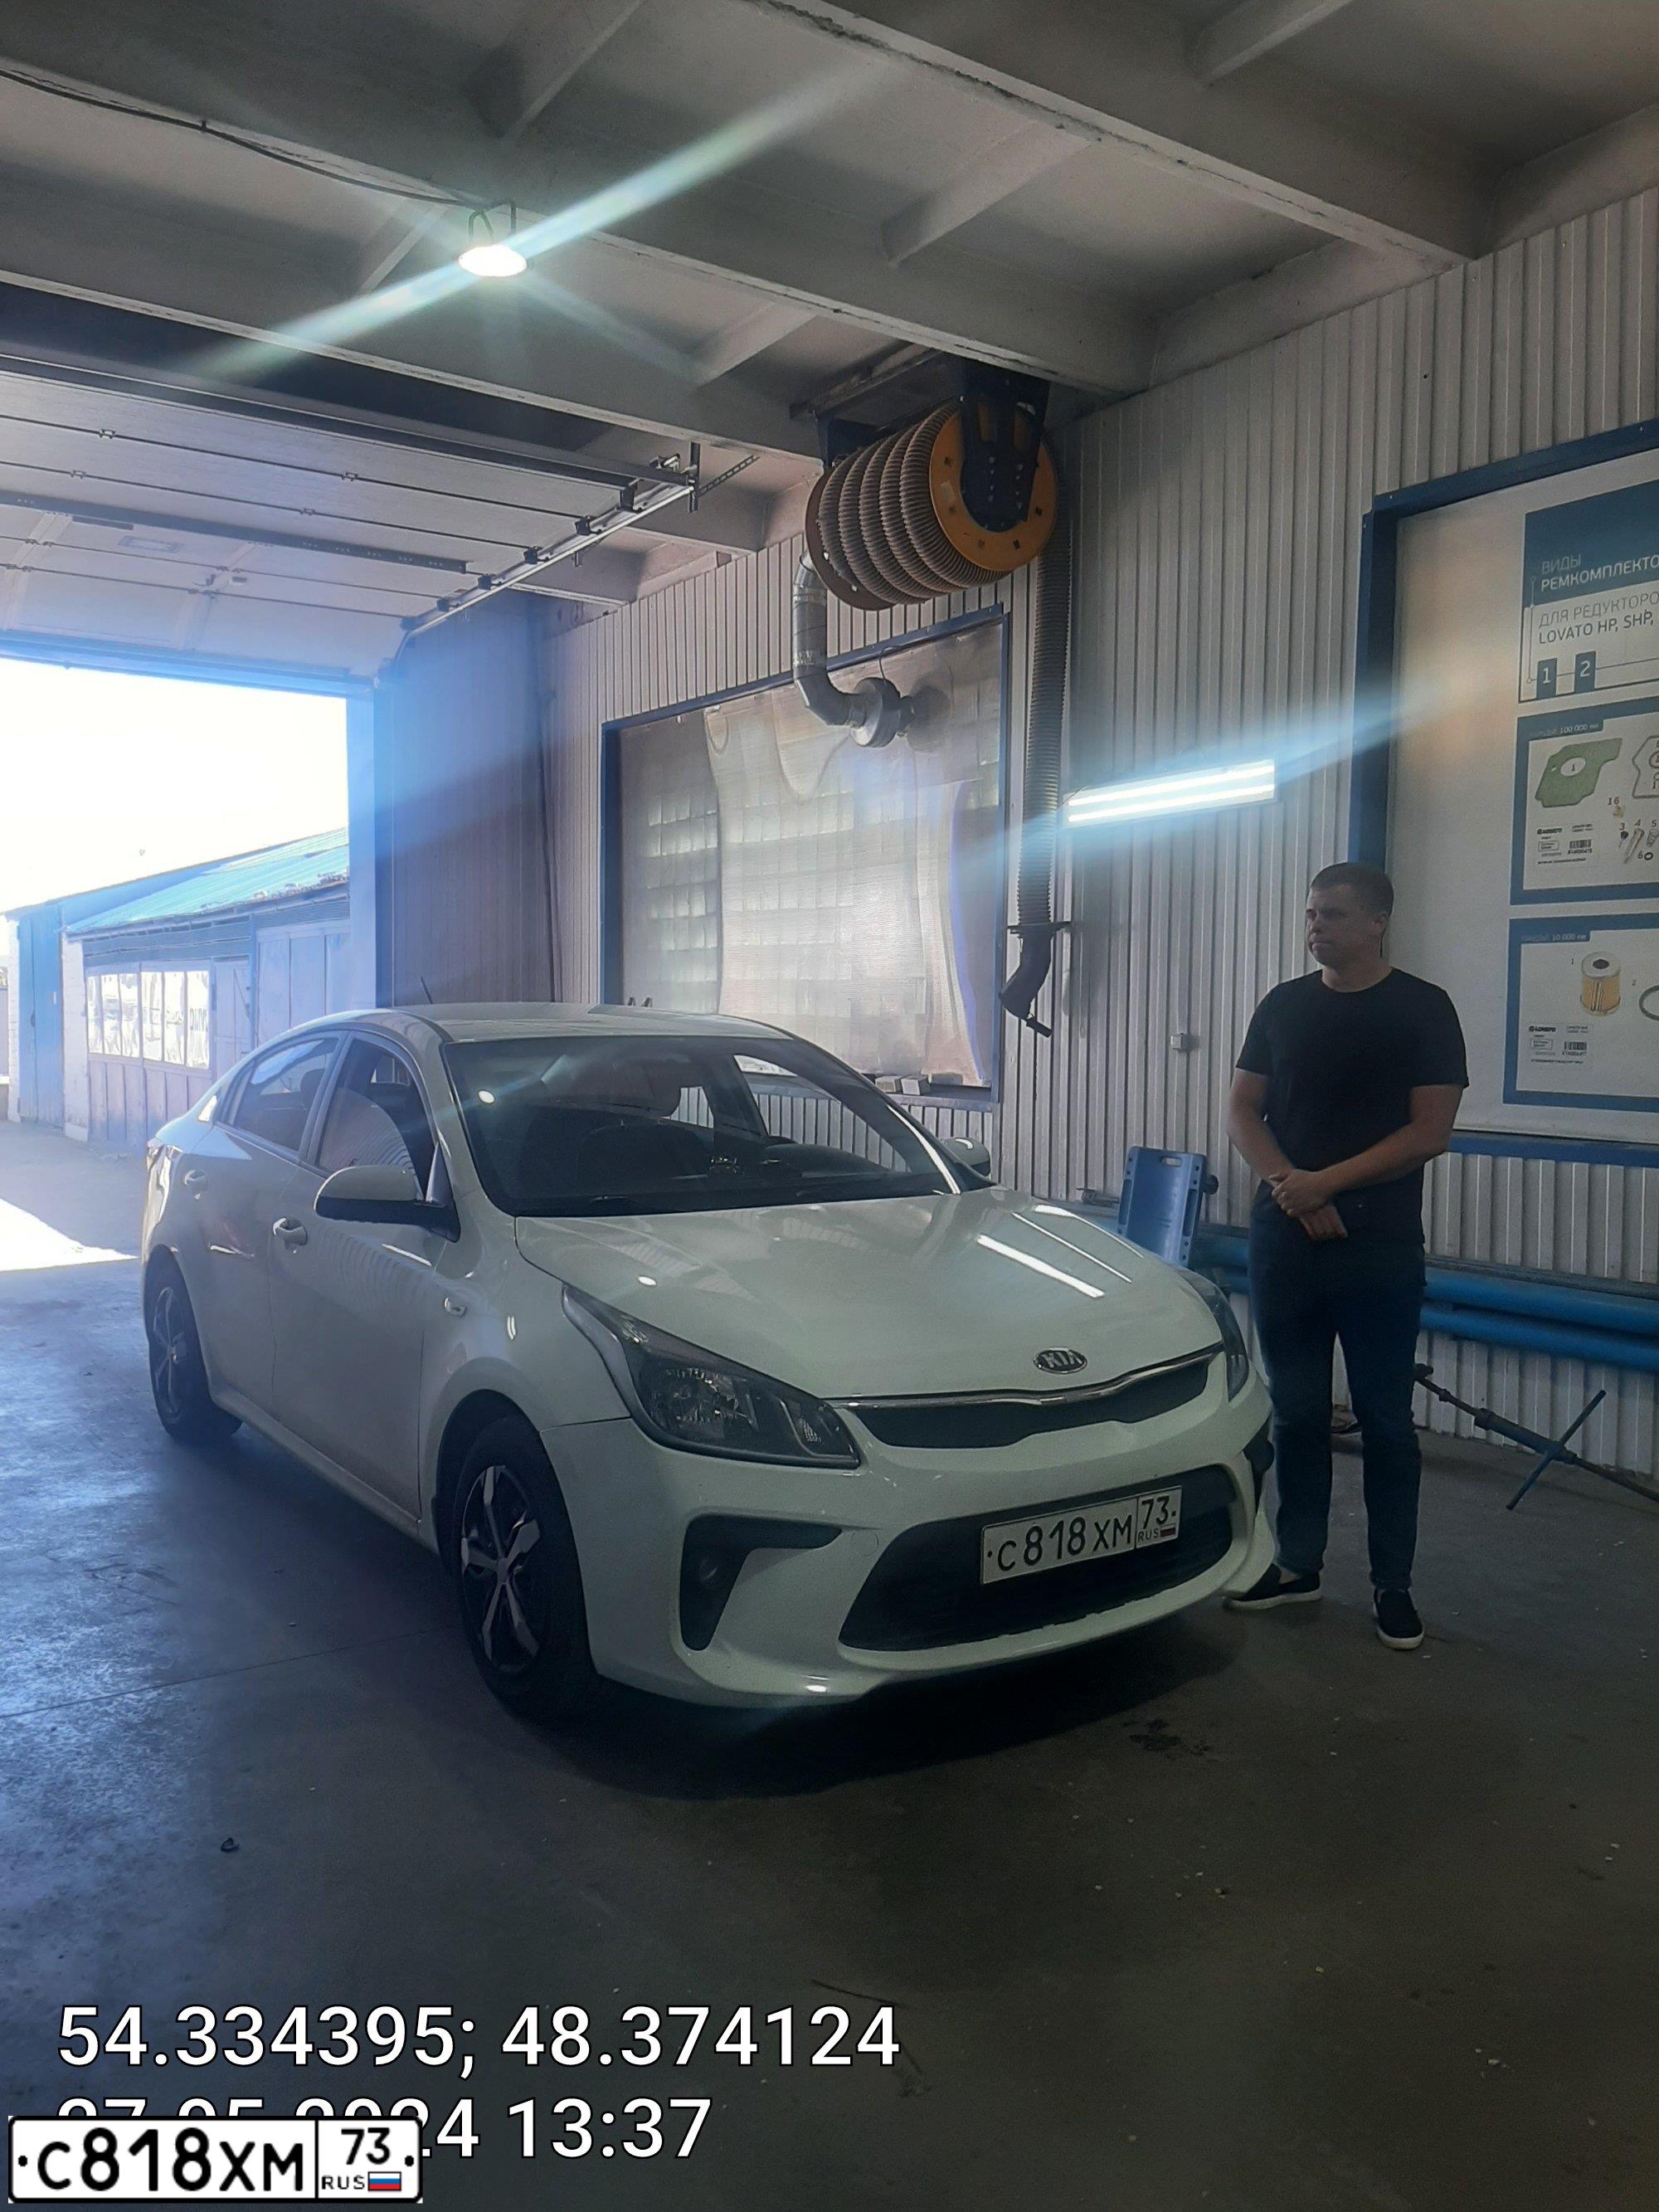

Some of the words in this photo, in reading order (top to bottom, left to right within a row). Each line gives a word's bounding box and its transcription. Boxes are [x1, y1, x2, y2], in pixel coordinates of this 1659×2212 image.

[1542, 553, 1581, 574] ВИДЫ
[1539, 609, 1569, 629] ДЛЯ
[1540, 623, 1593, 644] LOVATO
[1598, 618, 1618, 633] HP,
[1623, 609, 1654, 628] SHP,
[1543, 667, 1551, 684] 1
[1580, 660, 1590, 677] 2
[1039, 1351, 1083, 1369] KIA
[998, 1515, 1132, 1571] С818ХМ
[1141, 1496, 1170, 1529] 73
[1137, 1528, 1159, 1542] RUS
